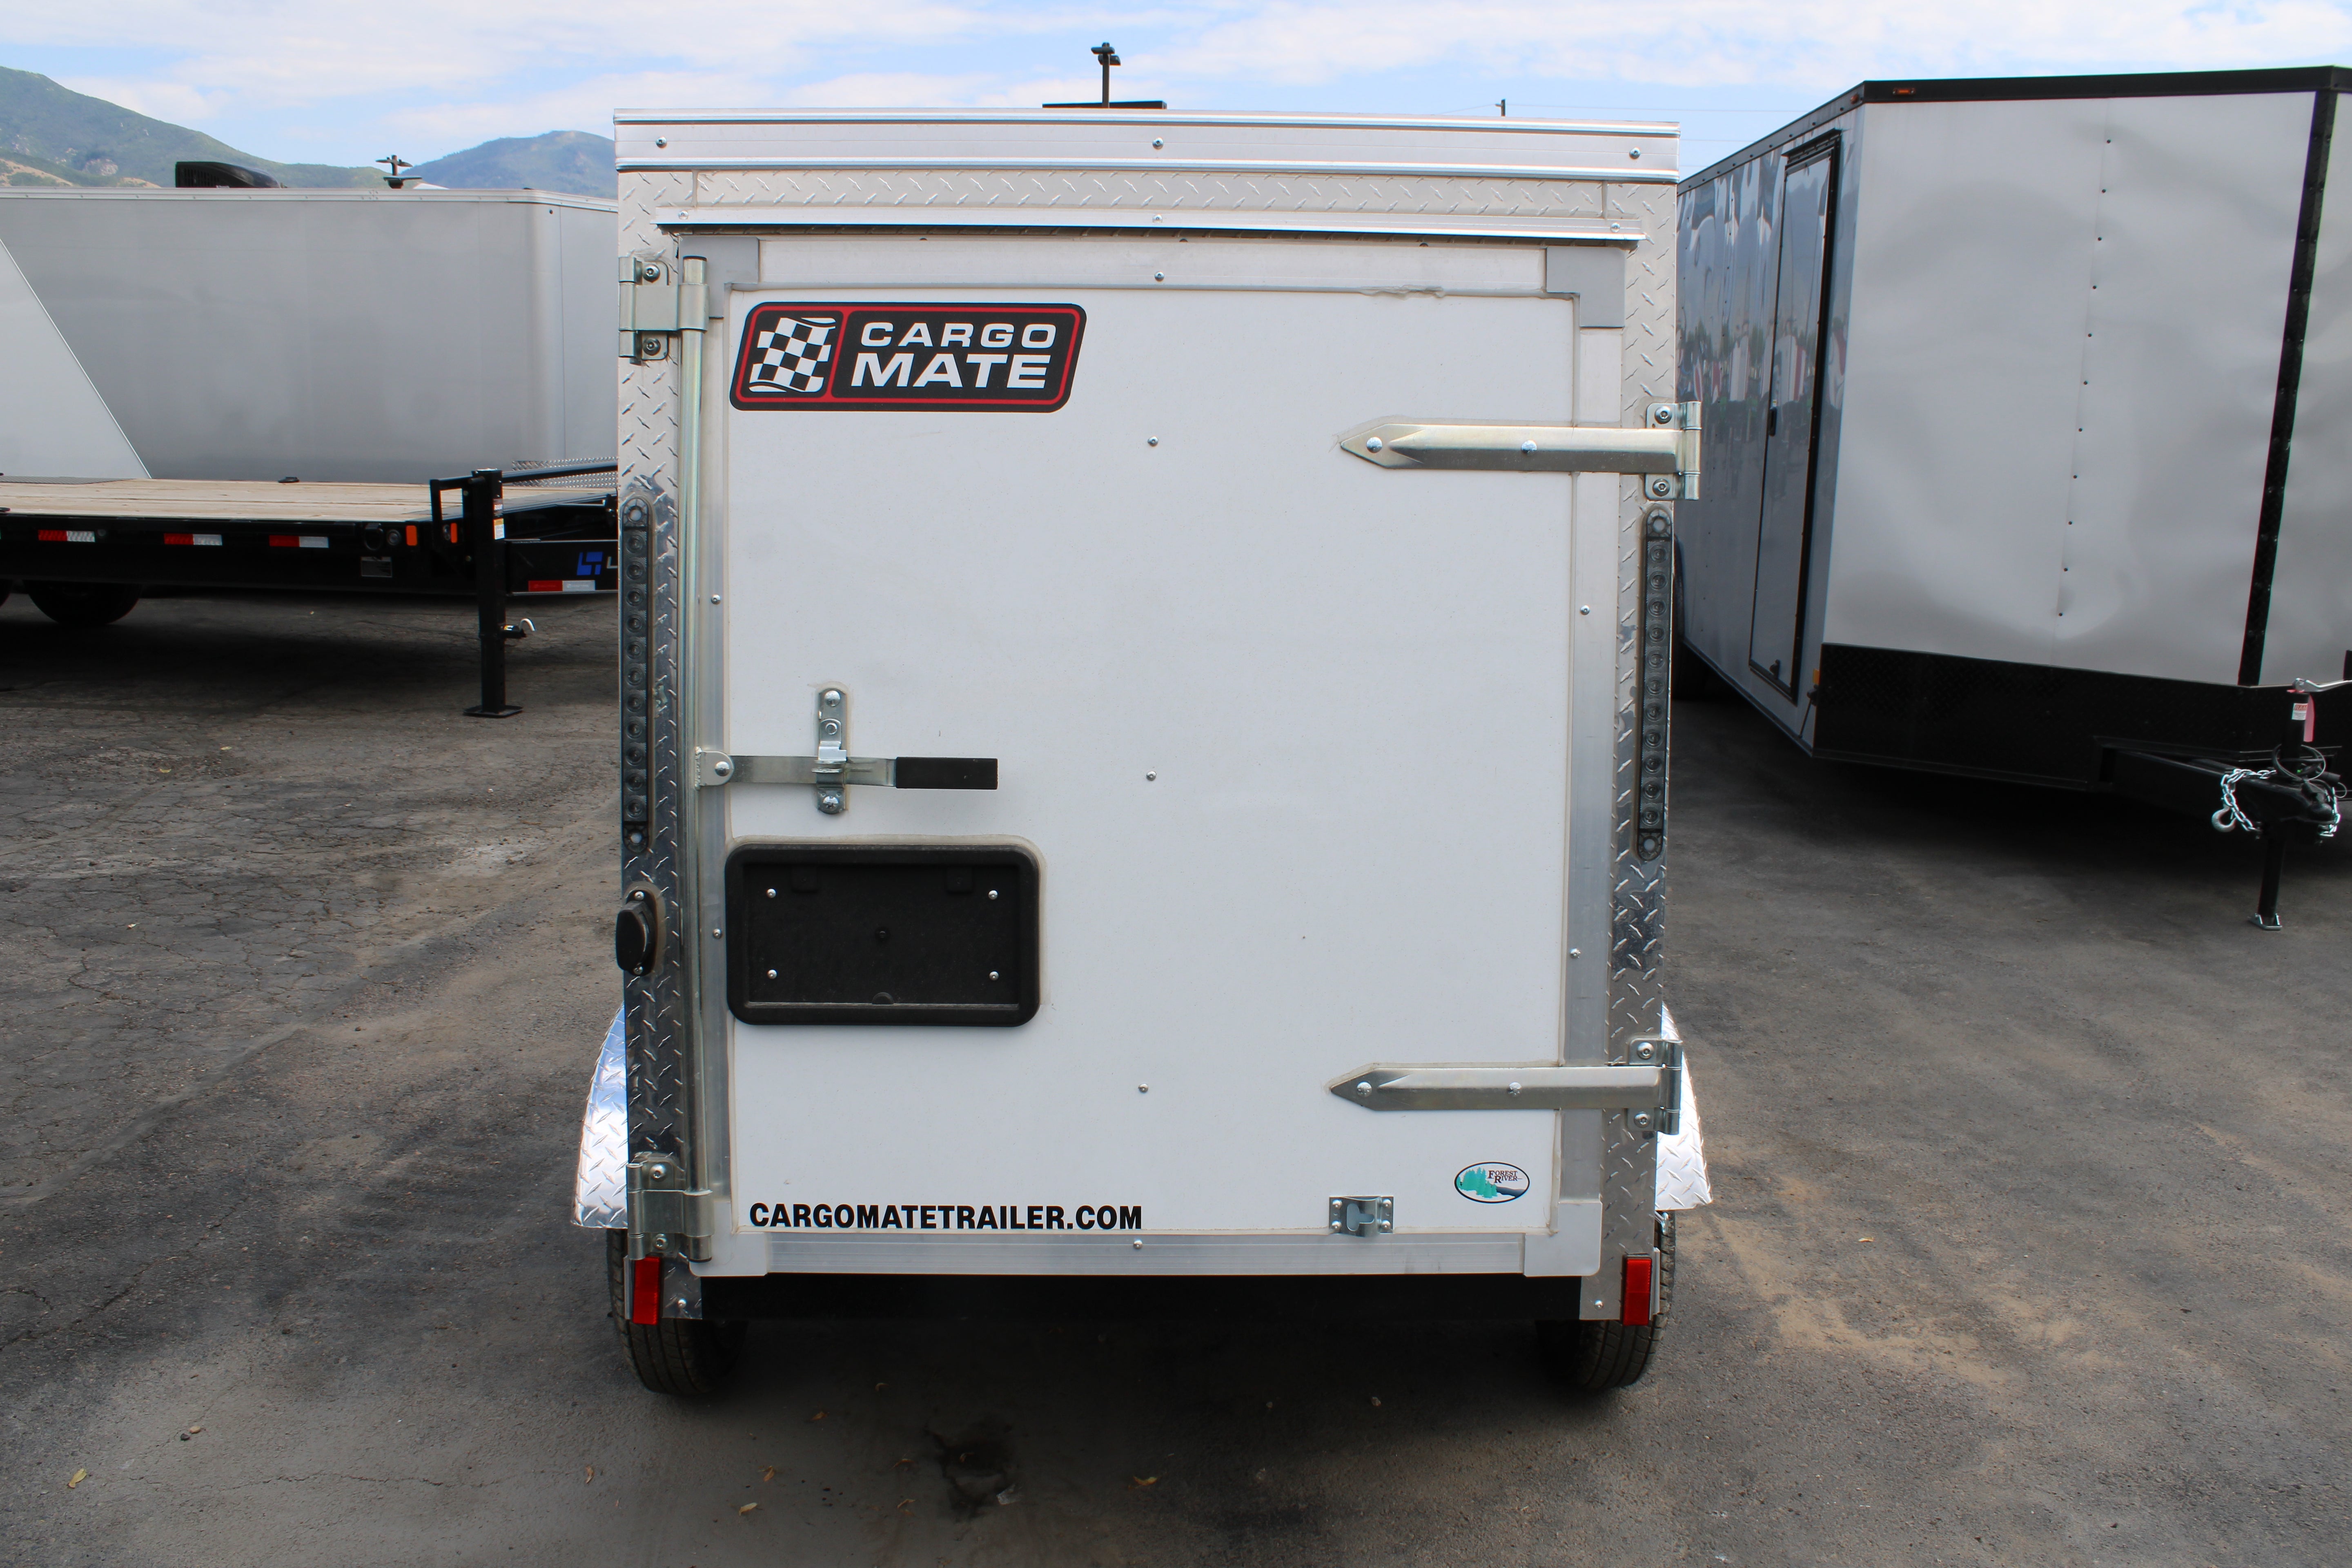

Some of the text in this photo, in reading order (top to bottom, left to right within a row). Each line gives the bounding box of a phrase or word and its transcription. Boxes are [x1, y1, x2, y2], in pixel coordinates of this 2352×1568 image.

[860, 322, 1057, 348] CARGO
[851, 352, 1051, 388] MATE
[1488, 1170, 1517, 1178] FOREST
[750, 1203, 1142, 1230] CARGOMATETRAILER.COM
